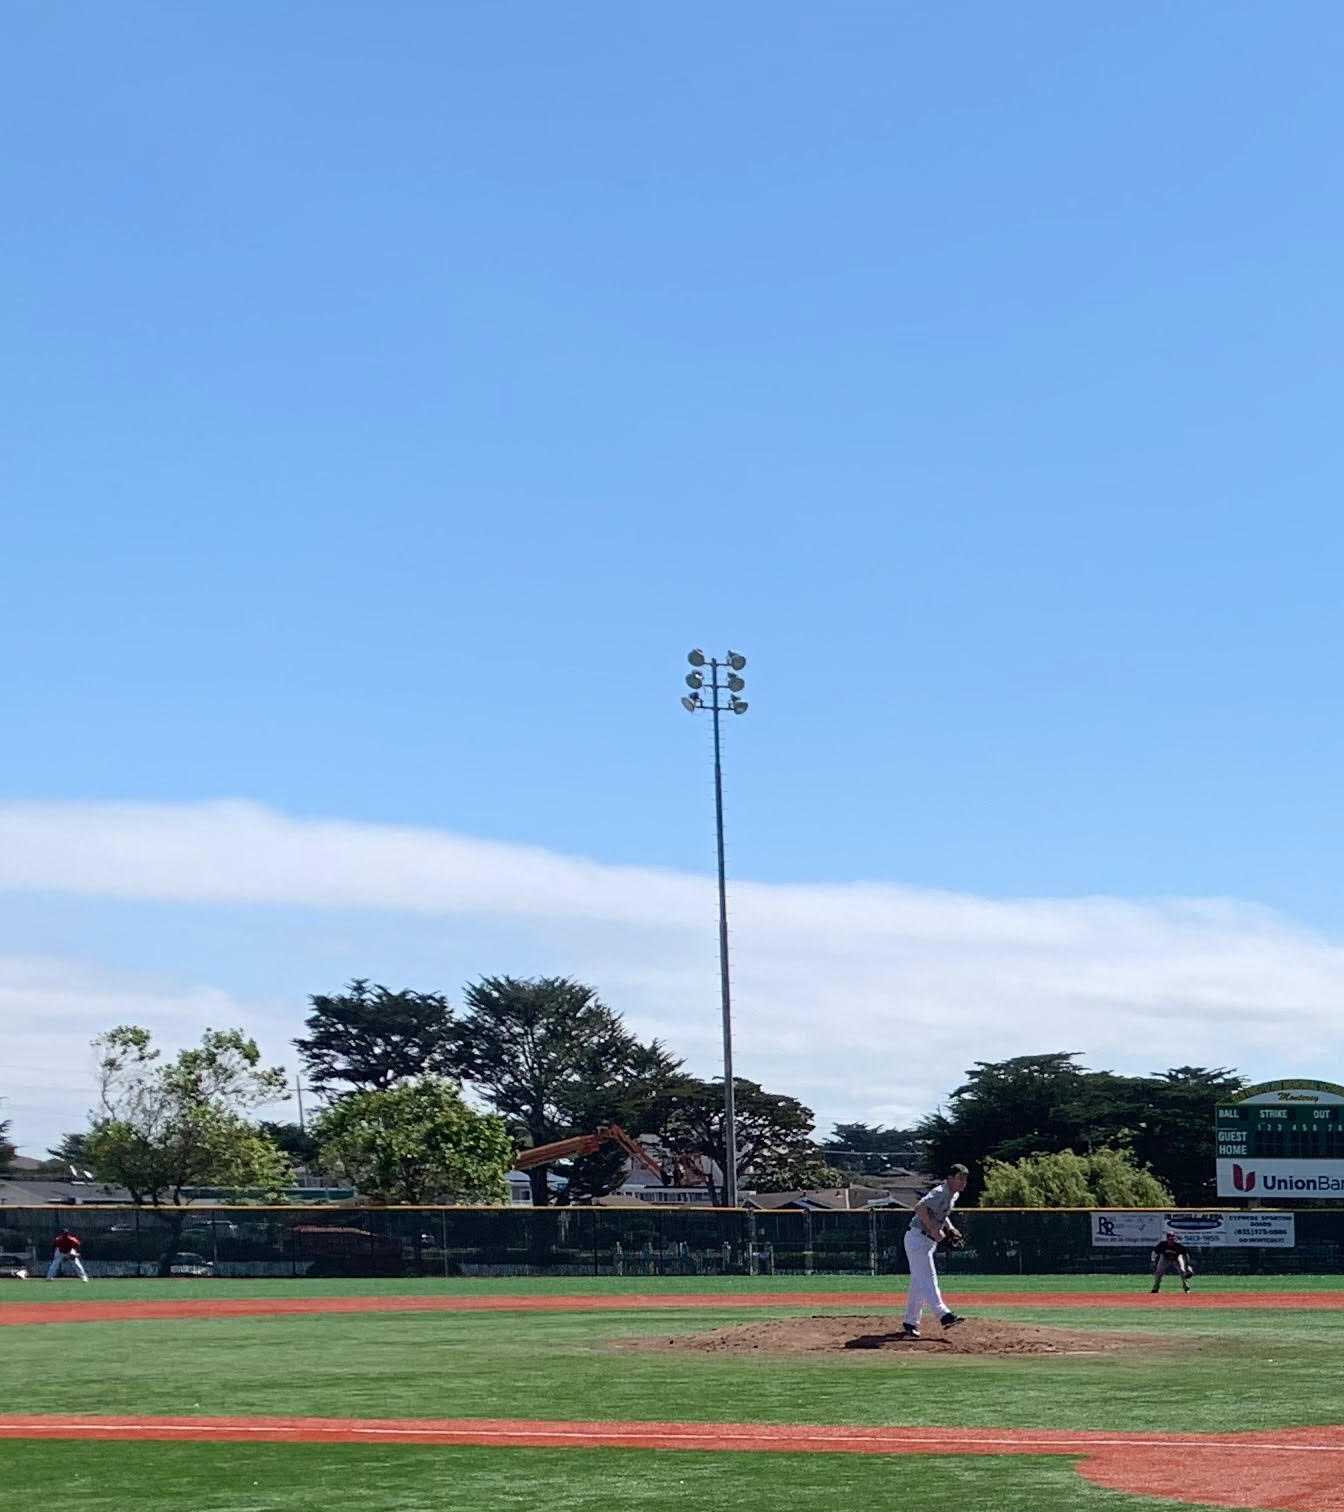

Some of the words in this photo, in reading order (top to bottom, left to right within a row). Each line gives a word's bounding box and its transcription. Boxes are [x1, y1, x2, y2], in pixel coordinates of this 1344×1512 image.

[1218, 1109, 1240, 1119] BALL
[1259, 1109, 1288, 1119] STRIKE
[1313, 1109, 1330, 1119] OUT
[1218, 1131, 1247, 1142] GUEST
[1219, 1144, 1247, 1155] HOME
